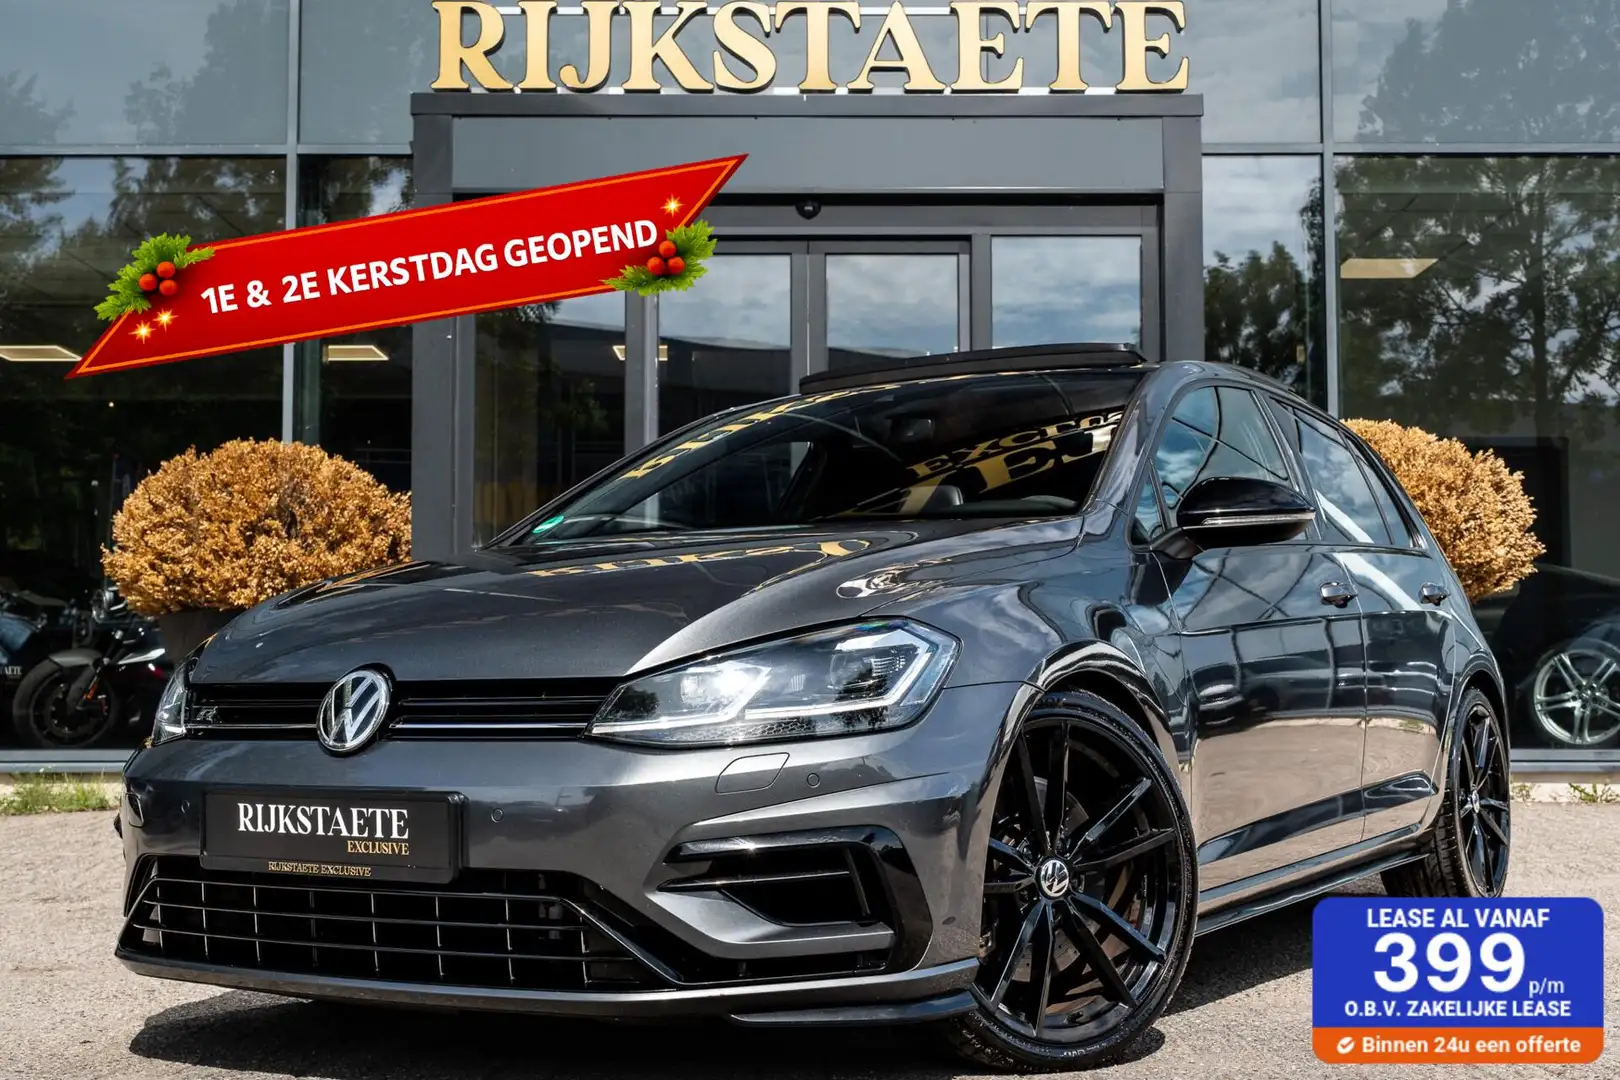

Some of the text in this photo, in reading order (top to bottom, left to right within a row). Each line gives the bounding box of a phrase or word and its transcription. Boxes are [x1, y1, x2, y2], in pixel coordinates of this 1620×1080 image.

[430, 0, 1190, 94] RIJKSTAETE
[237, 802, 409, 839] RIJKSTAETE
[346, 840, 410, 856] EXCLUSIVE
[268, 861, 372, 877] RIJKSTAETE EXCLUSIVE
